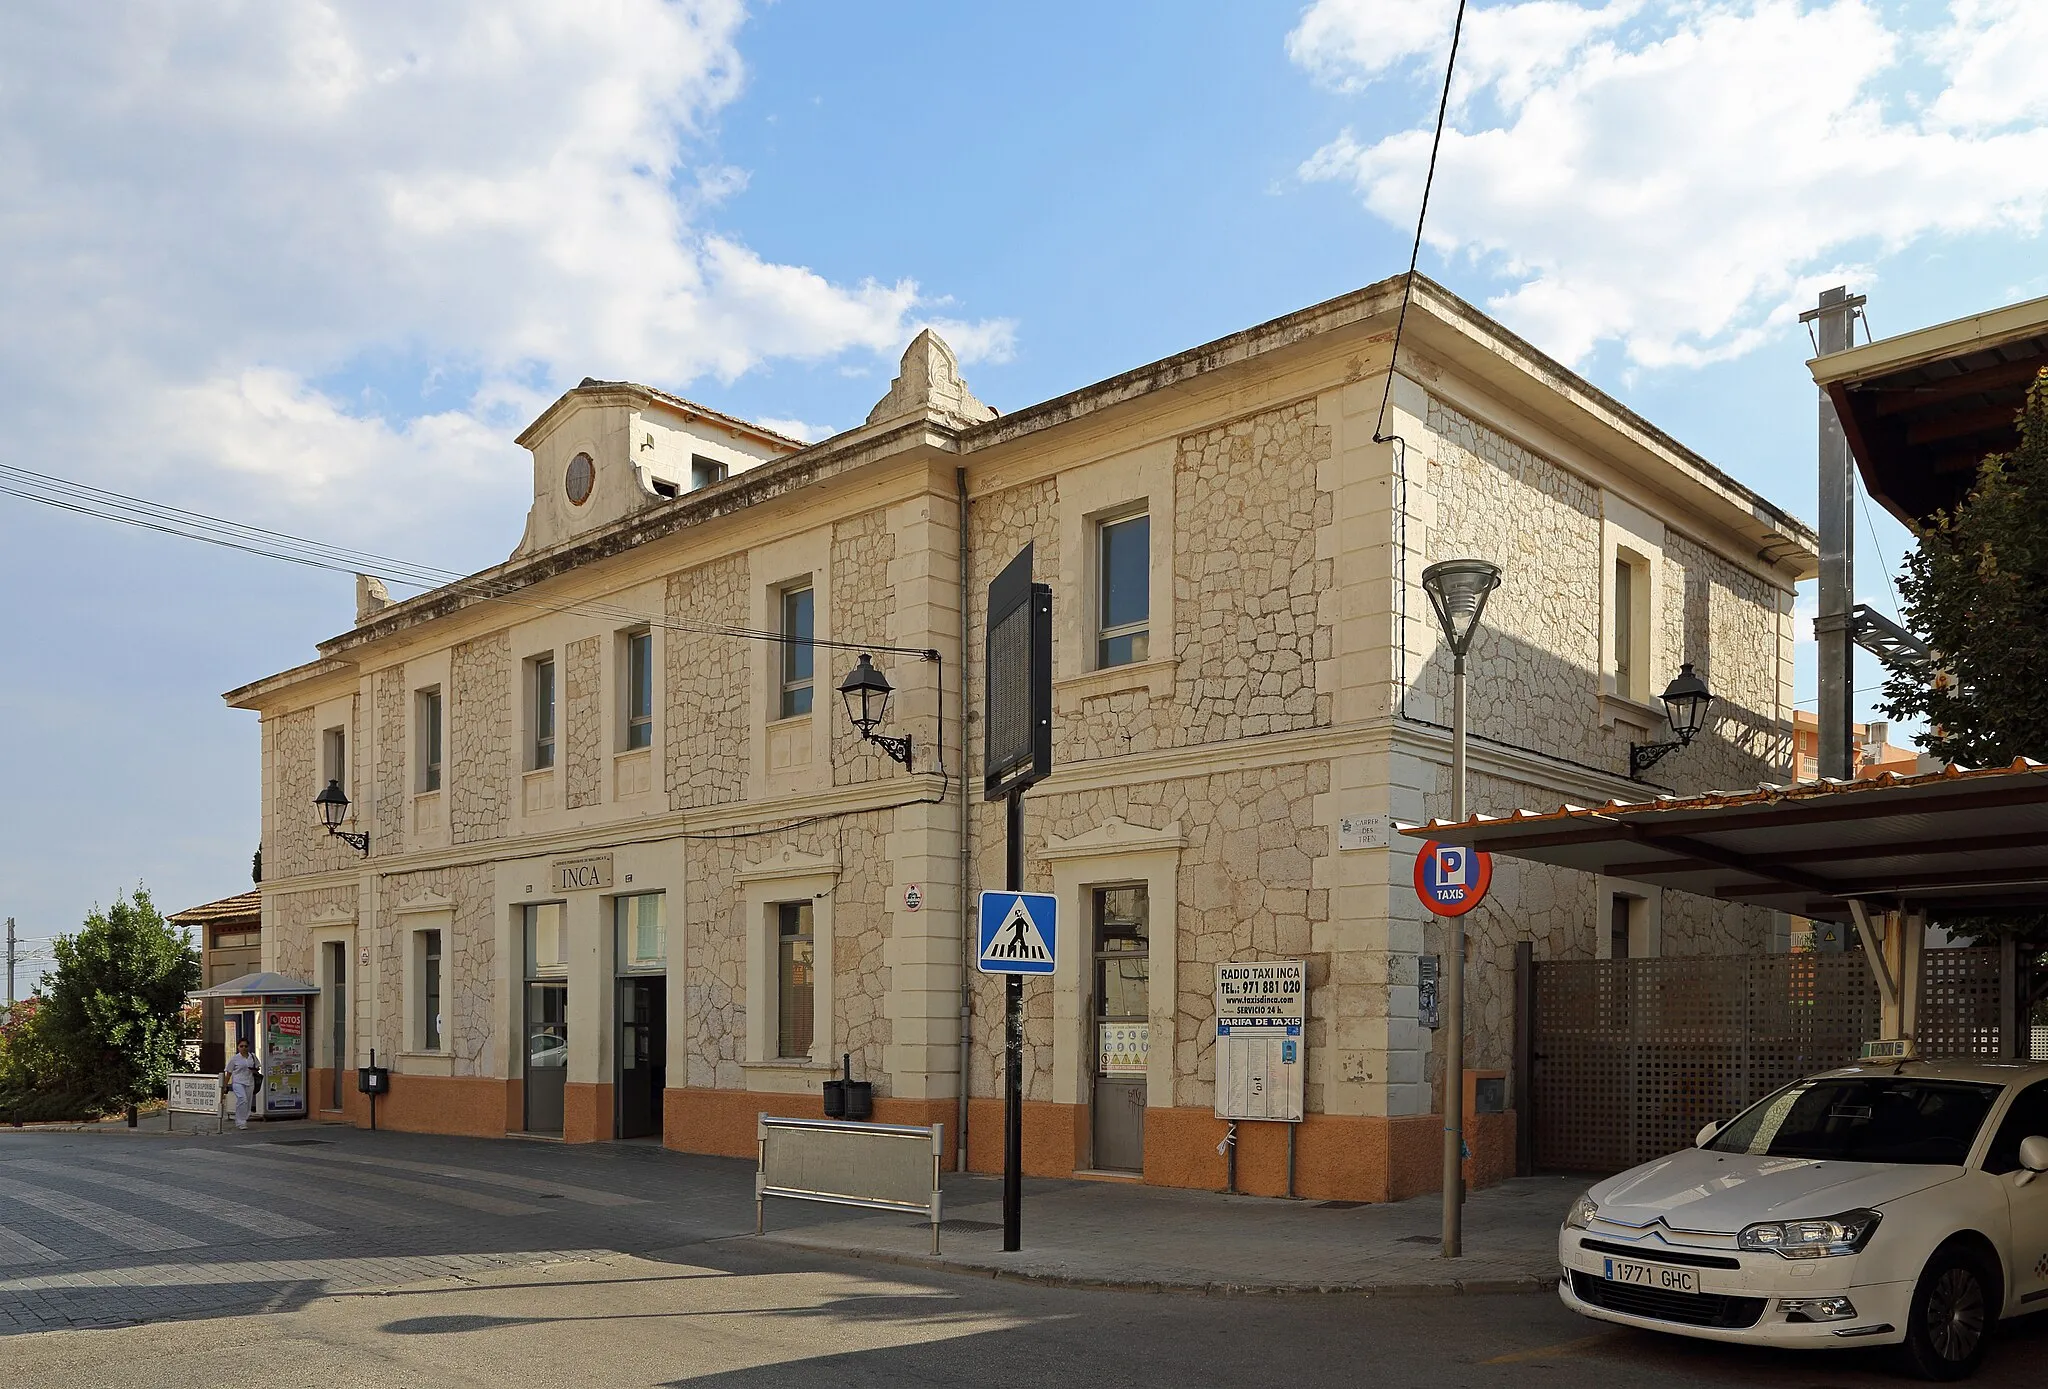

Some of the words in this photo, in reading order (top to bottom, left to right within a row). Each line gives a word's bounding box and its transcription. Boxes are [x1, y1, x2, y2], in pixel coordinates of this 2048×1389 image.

[1358, 835, 1377, 843] TREN
[562, 866, 600, 888] INCA
[1437, 889, 1464, 900] TAXIS
[1221, 968, 1250, 979] RADIO
[1252, 967, 1274, 979] TAXI
[1276, 967, 1300, 979] INCA
[1221, 982, 1240, 994] TEL.:
[1242, 981, 1259, 994] 971
[1262, 980, 1279, 993] 881
[1283, 980, 1301, 993] 020
[1226, 995, 1294, 1004] www.taxisdinca.com
[1236, 1006, 1266, 1014] SERVICIO
[1267, 1006, 1275, 1014] 24
[1276, 1005, 1284, 1014] h.
[280, 1016, 301, 1024] FOTOS
[1220, 1018, 1252, 1026] TARIFA
[1255, 1018, 1268, 1026] DE
[1271, 1018, 1301, 1026] TAXIS
[1872, 1043, 1894, 1056] TAXI
[1617, 1263, 1652, 1284] 1771
[1661, 1270, 1692, 1290] GHC
